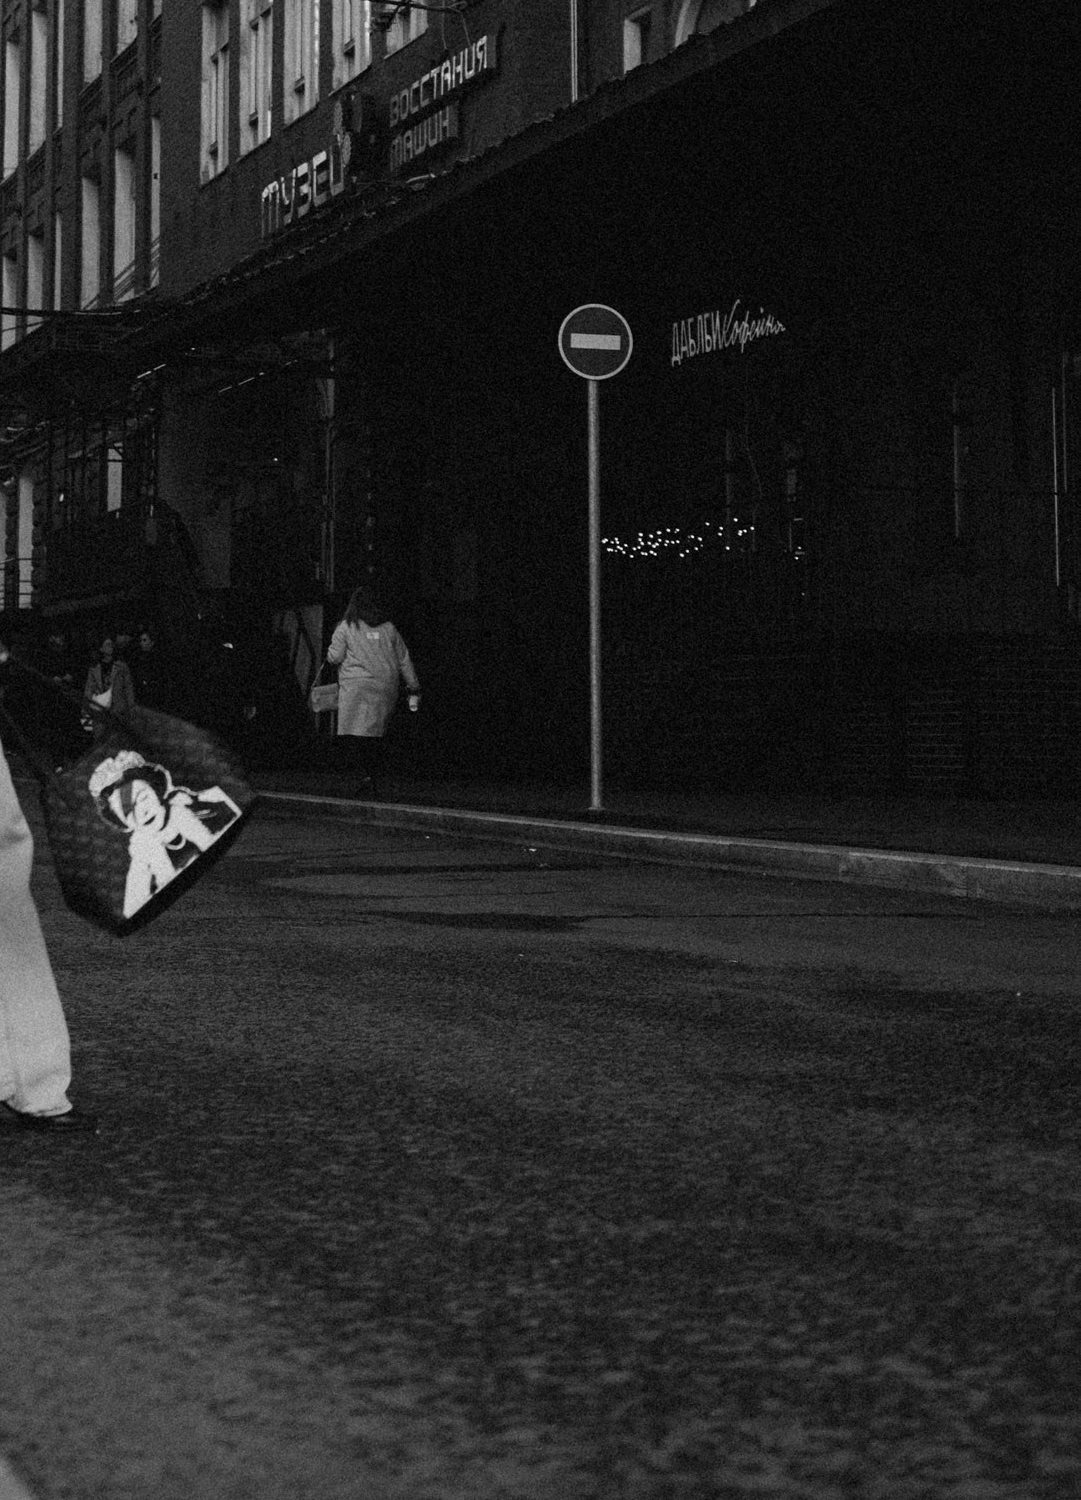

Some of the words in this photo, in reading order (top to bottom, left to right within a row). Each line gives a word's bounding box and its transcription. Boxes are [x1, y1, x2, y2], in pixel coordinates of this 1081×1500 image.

[389, 35, 488, 128] ВОССТАНИЯ
[390, 105, 450, 171] МАШИН
[671, 310, 723, 367] ДАБЛБИ
